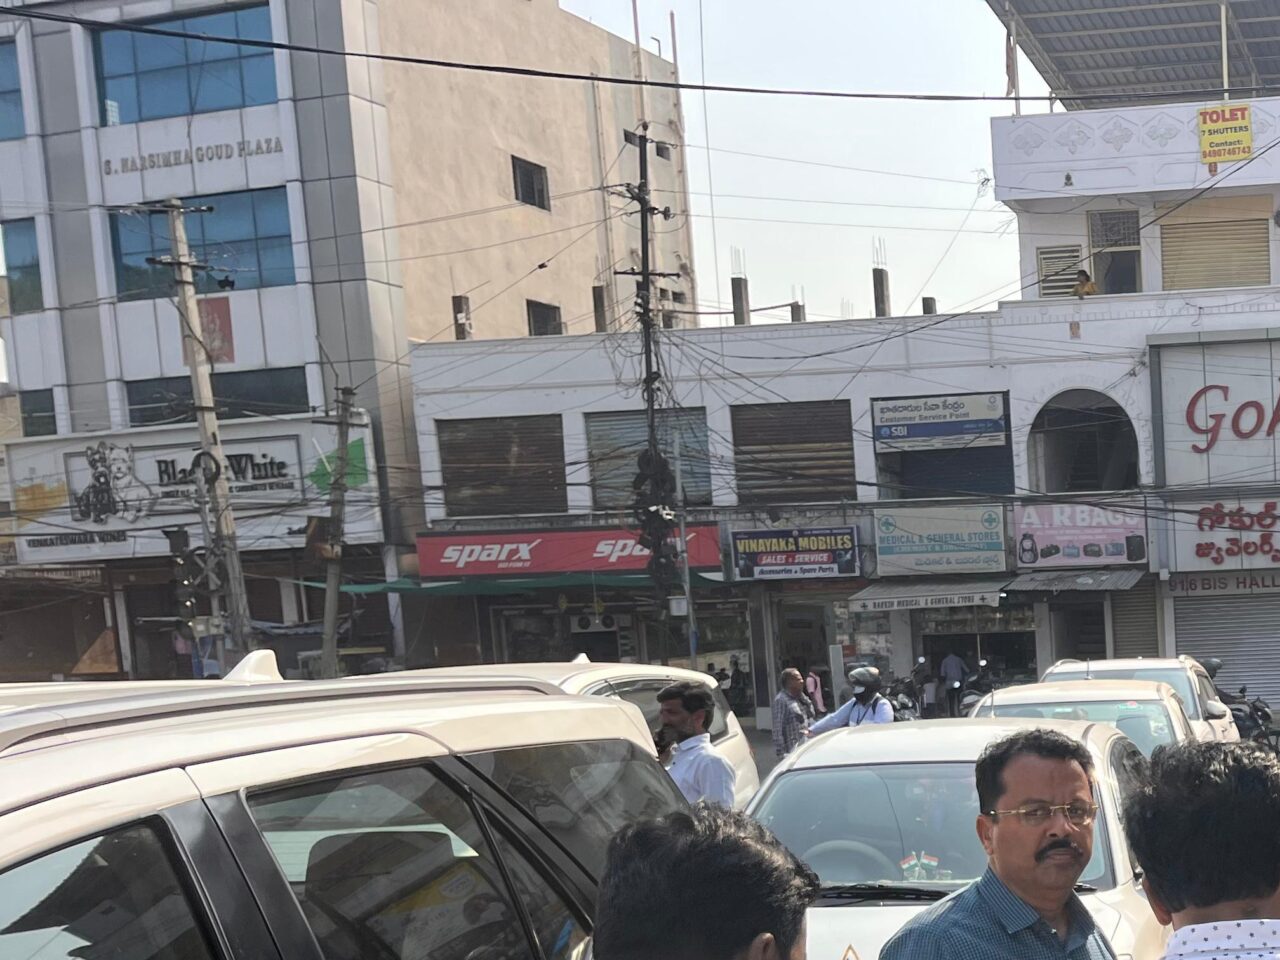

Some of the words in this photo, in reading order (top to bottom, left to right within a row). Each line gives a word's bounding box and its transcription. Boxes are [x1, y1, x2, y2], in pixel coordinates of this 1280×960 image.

[1200, 107, 1248, 124] TOLET
[1208, 125, 1249, 136] SHUTTERS
[196, 143, 234, 163] GOUD
[237, 136, 283, 158] PLAZA
[919, 413, 947, 421] Service
[891, 426, 908, 436] SBI
[225, 453, 289, 481] White
[736, 537, 796, 553] VINAYAKA
[798, 534, 852, 551] MOBILES
[880, 534, 915, 545] MEDICAL
[926, 532, 965, 543] GENERAL
[968, 531, 1000, 541] STORES
[440, 538, 542, 568] sparx
[761, 554, 786, 564] SALES
[795, 553, 828, 563] SERVICE
[799, 566, 817, 574] Spare
[818, 565, 835, 573] Parts
[1201, 577, 1228, 591] BIS
[897, 599, 921, 609] MEDICAL
[930, 596, 955, 606] GENERAL
[957, 595, 975, 604] STORE
